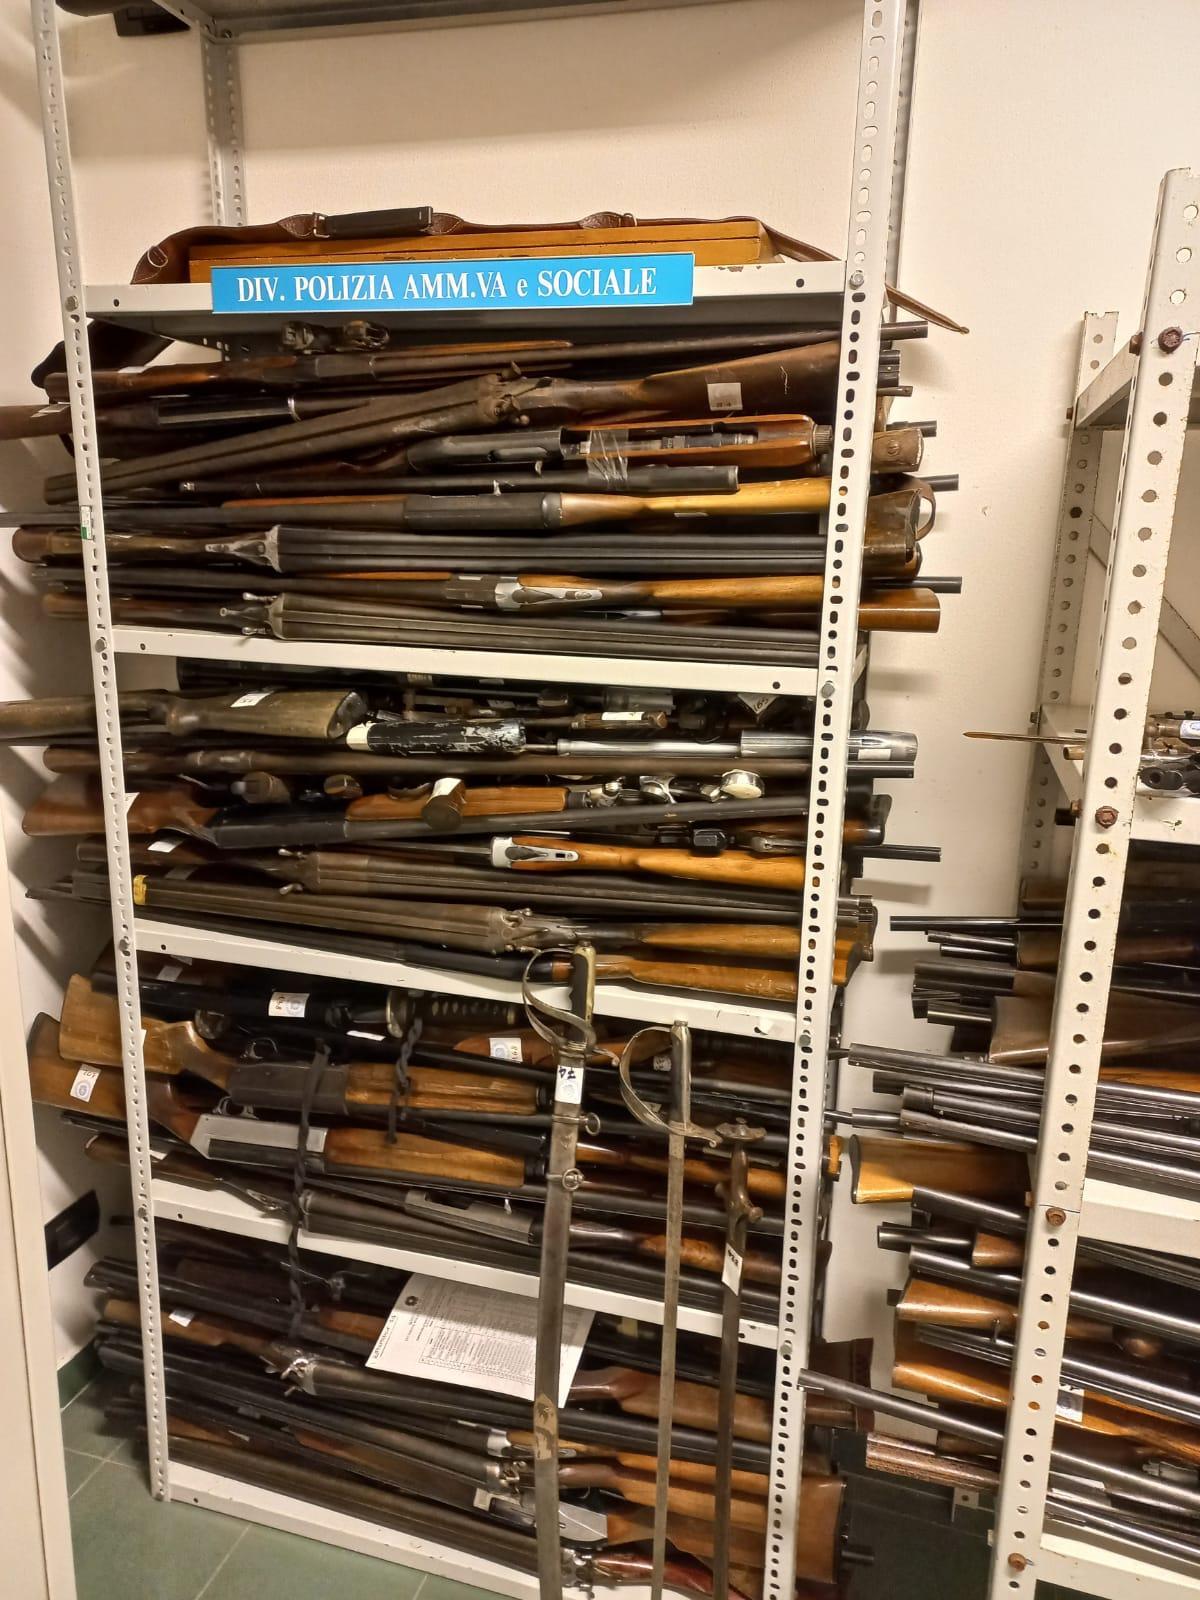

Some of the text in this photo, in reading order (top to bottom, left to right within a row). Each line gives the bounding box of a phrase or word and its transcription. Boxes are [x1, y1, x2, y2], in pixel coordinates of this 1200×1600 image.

[236, 267, 657, 302] DIV. POLIZIA AMM.VA e SOCIALE
